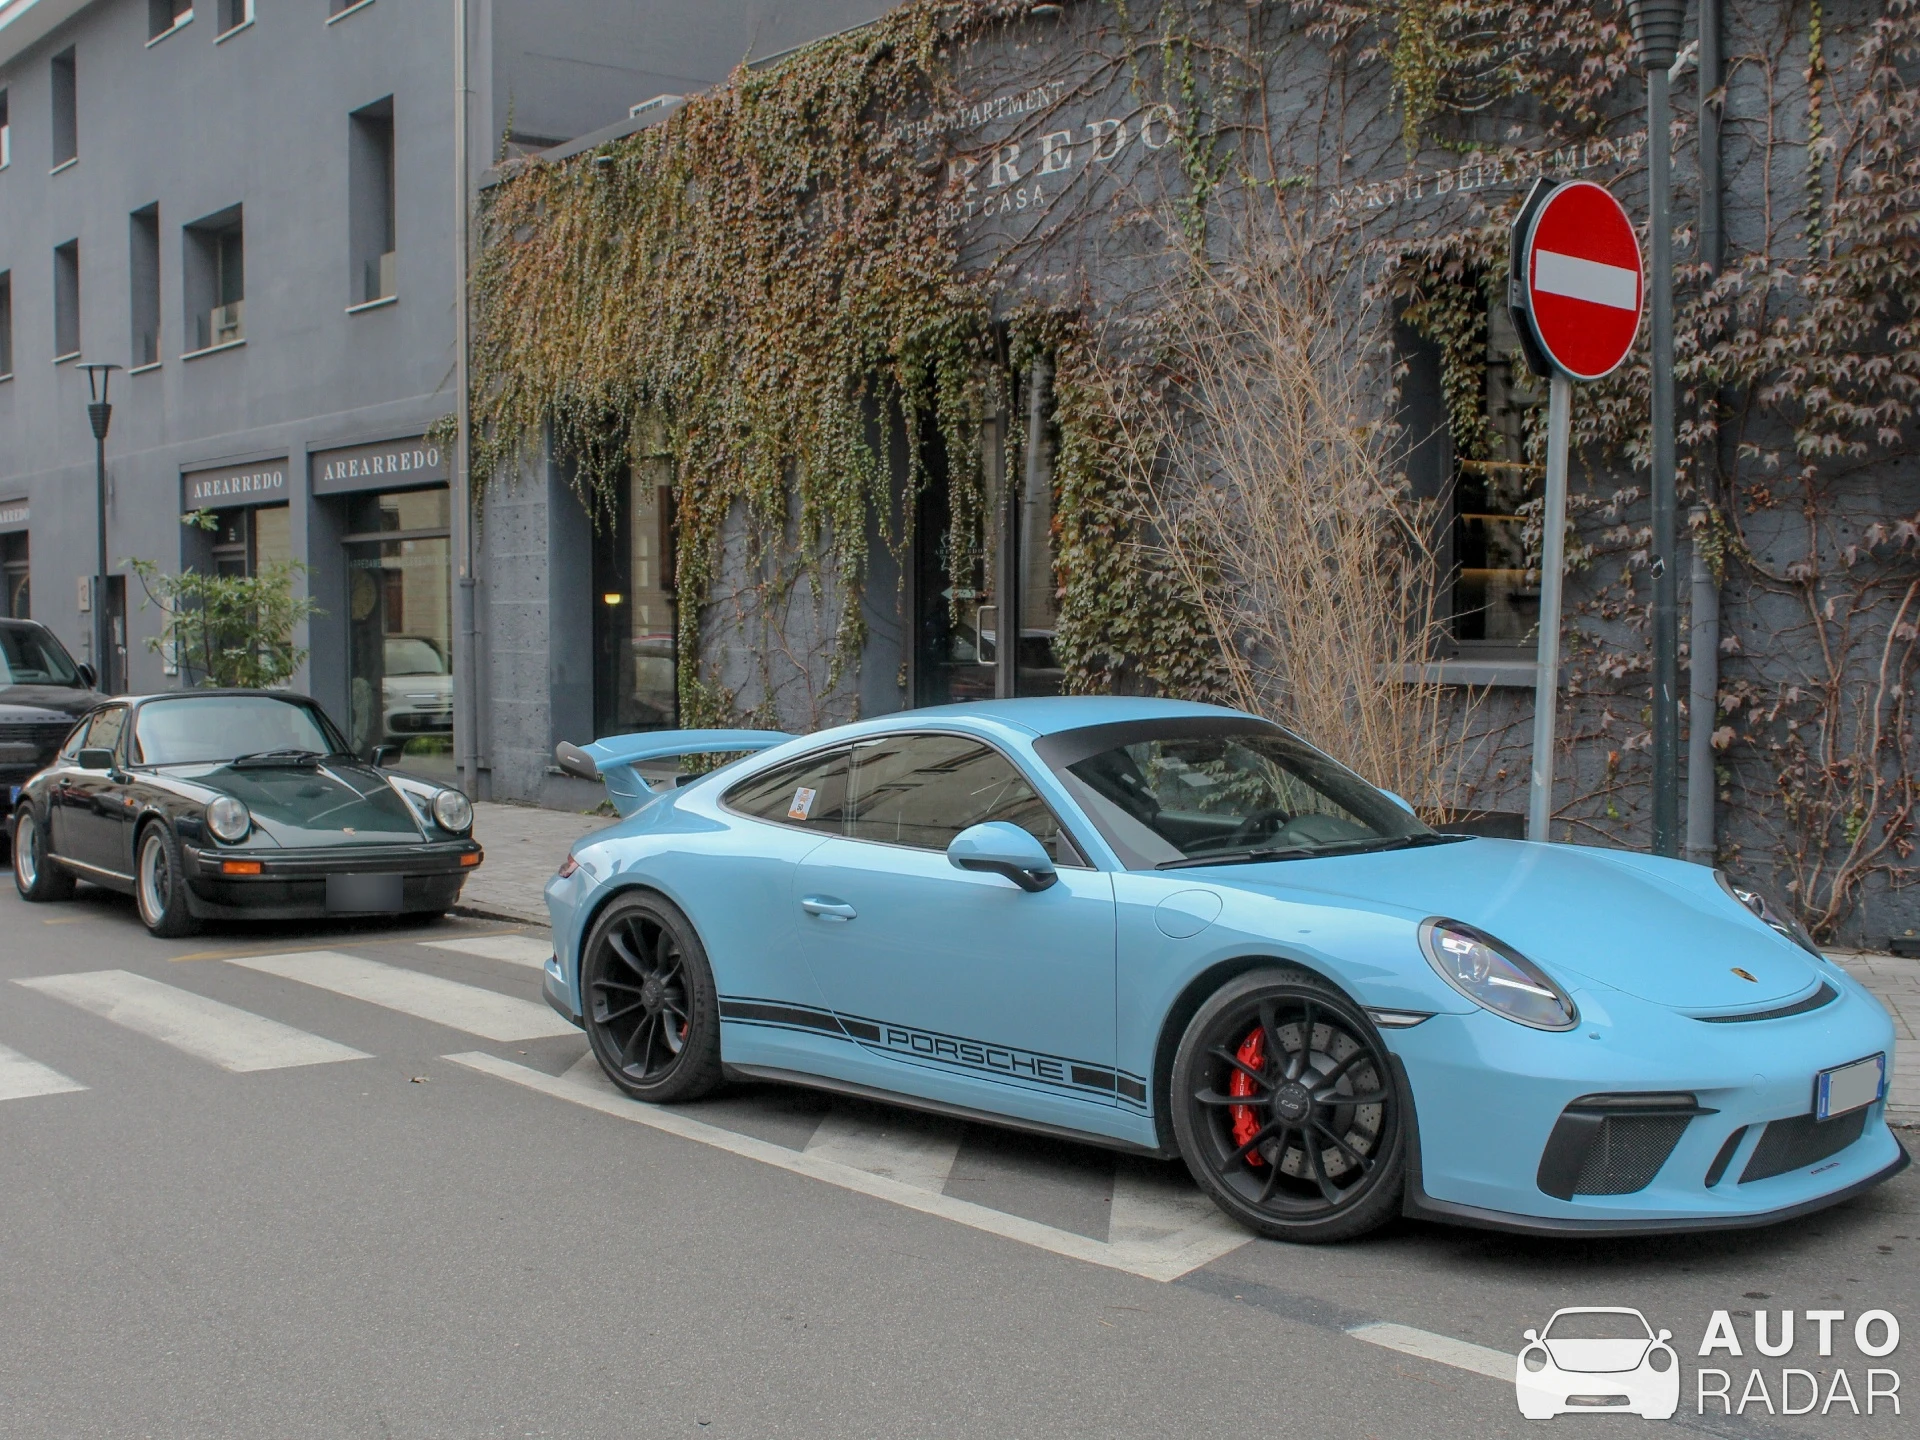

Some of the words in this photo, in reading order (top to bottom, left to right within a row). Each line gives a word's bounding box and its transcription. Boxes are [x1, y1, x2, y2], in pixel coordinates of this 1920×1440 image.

[937, 80, 1065, 134] PARTMENT
[948, 104, 1179, 193] RREDO
[982, 184, 1044, 217] CASA
[193, 470, 283, 499] AREARREDO
[324, 447, 439, 481] AREARREDO
[886, 1027, 1065, 1081] PORSCHE
